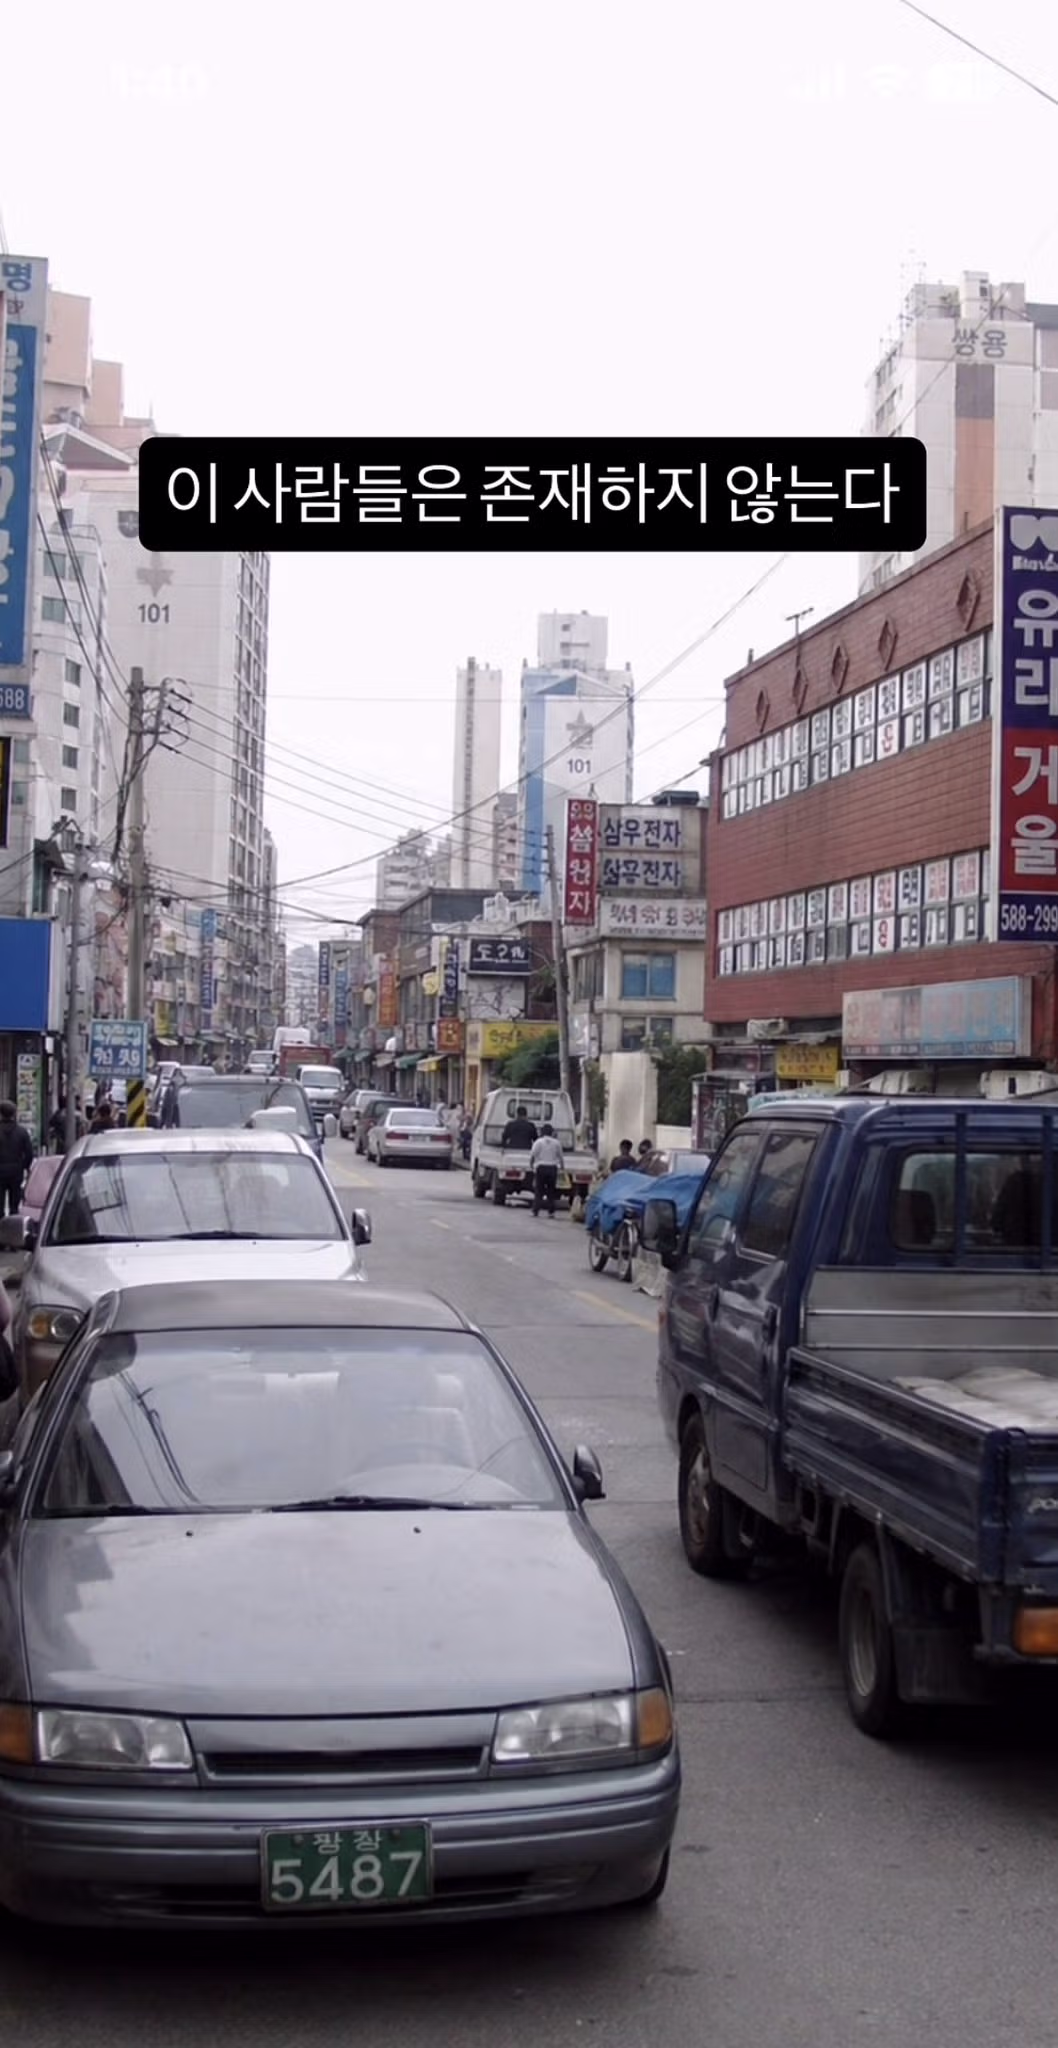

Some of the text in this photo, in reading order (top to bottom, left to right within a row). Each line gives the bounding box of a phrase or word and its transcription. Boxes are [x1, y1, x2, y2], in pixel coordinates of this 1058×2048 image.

[138, 603, 170, 624] 101
[568, 758, 592, 774] 101
[604, 818, 682, 848] 삼우전자
[271, 1852, 423, 1903] 5487
